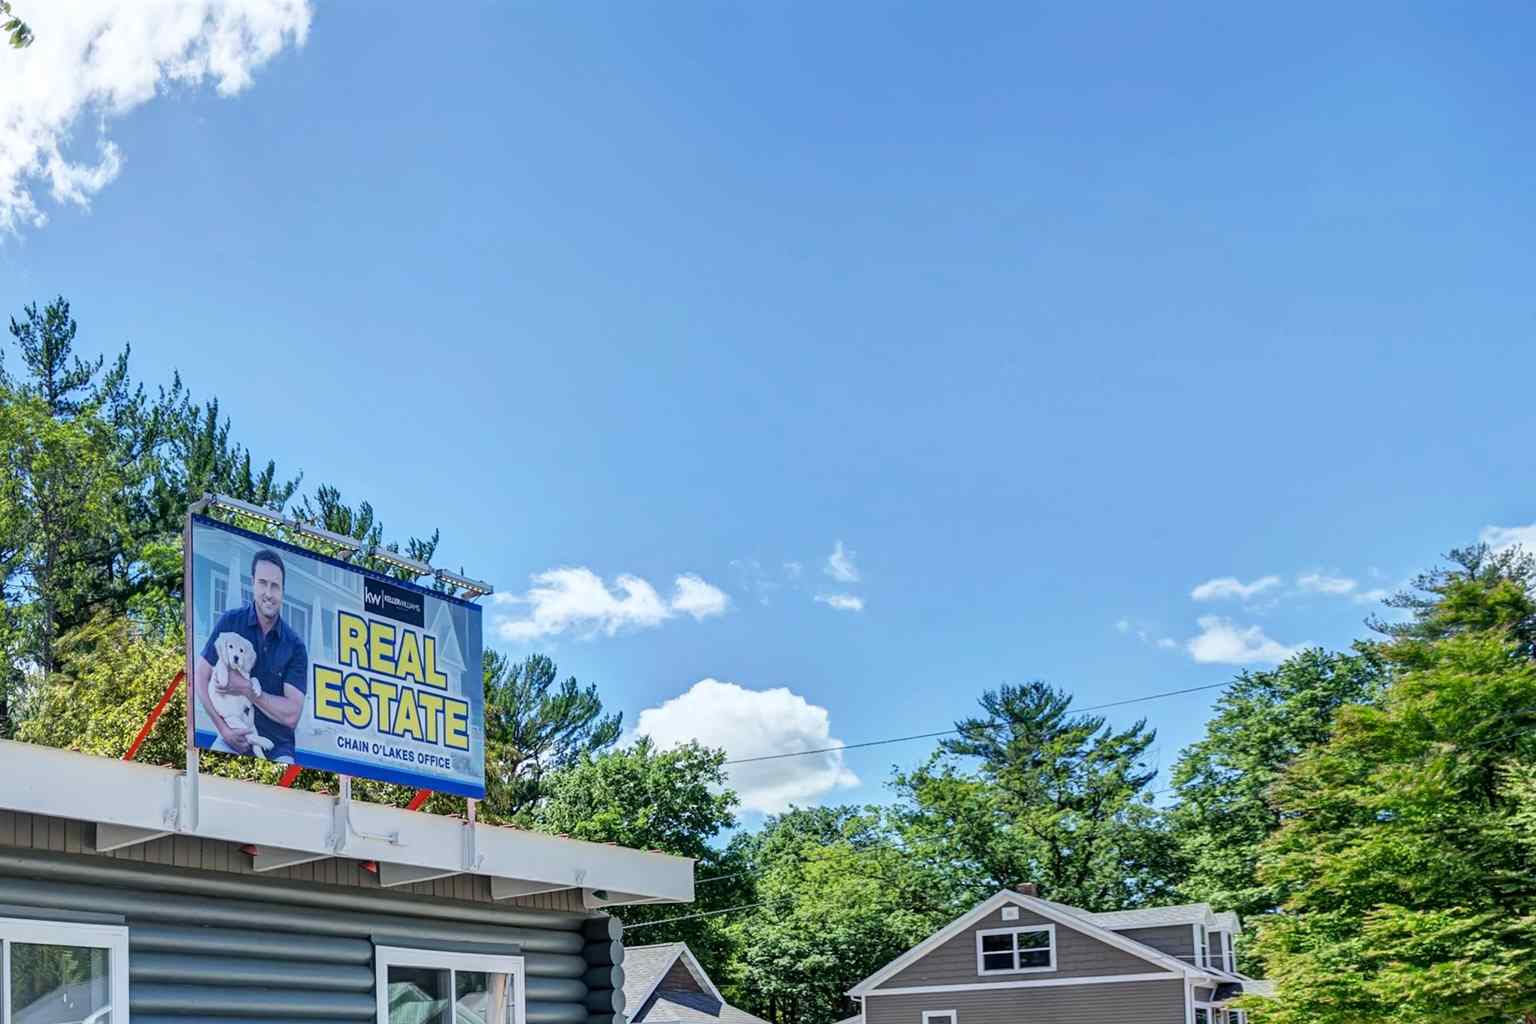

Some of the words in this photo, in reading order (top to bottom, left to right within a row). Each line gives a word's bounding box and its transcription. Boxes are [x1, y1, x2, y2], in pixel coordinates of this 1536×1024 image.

[365, 586, 381, 606] kw
[338, 610, 448, 691] REAL
[313, 664, 470, 752] ESTATE
[337, 735, 369, 753] CHAIN
[372, 743, 415, 762] O'LAKES
[418, 751, 451, 769] OFFICE
